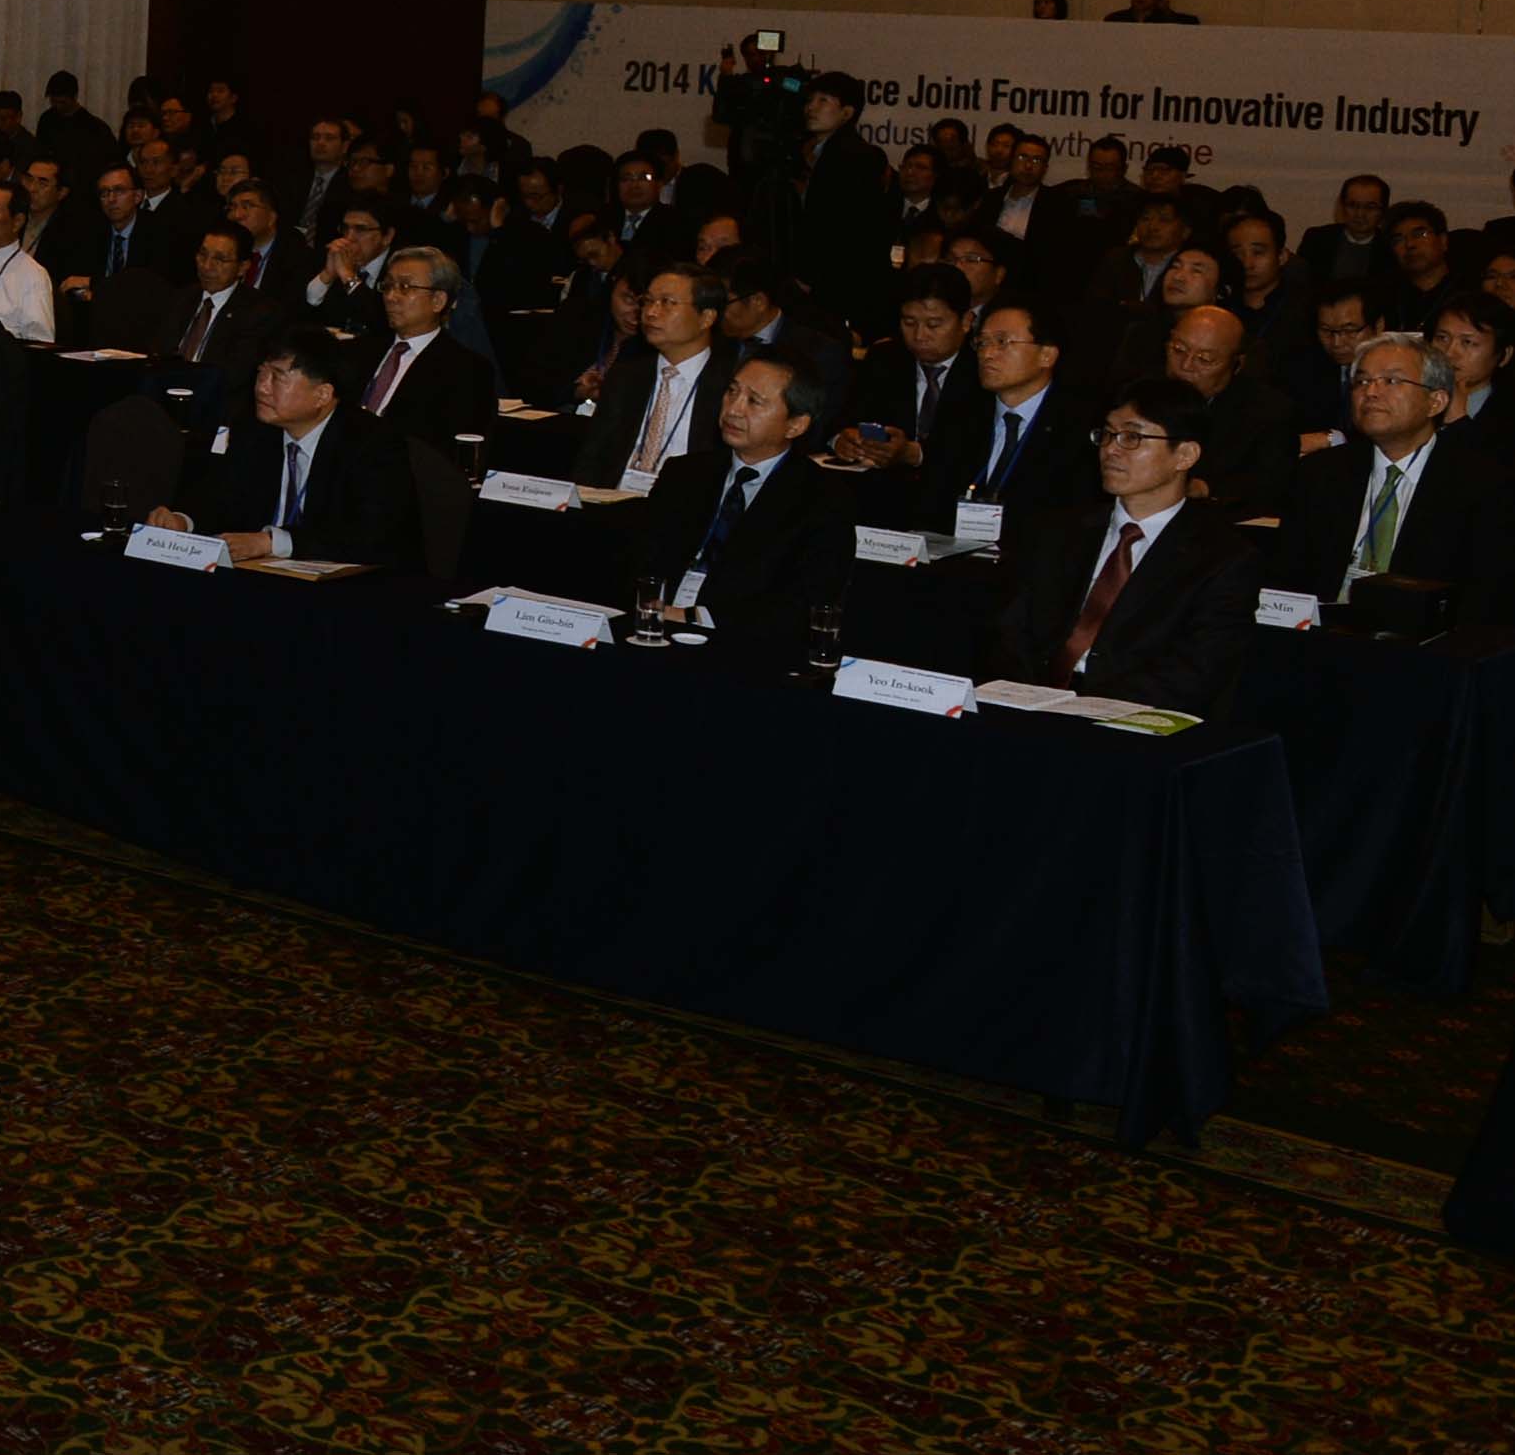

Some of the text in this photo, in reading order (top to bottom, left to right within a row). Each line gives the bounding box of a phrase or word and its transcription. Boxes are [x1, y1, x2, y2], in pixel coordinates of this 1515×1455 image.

[624, 60, 690, 94] 2014
[908, 74, 982, 111] Joint
[991, 79, 1089, 116] Forum
[1100, 84, 1144, 120] for
[1153, 86, 1324, 131] Innovative
[1335, 95, 1480, 147] Industry
[859, 118, 976, 146] ndustl
